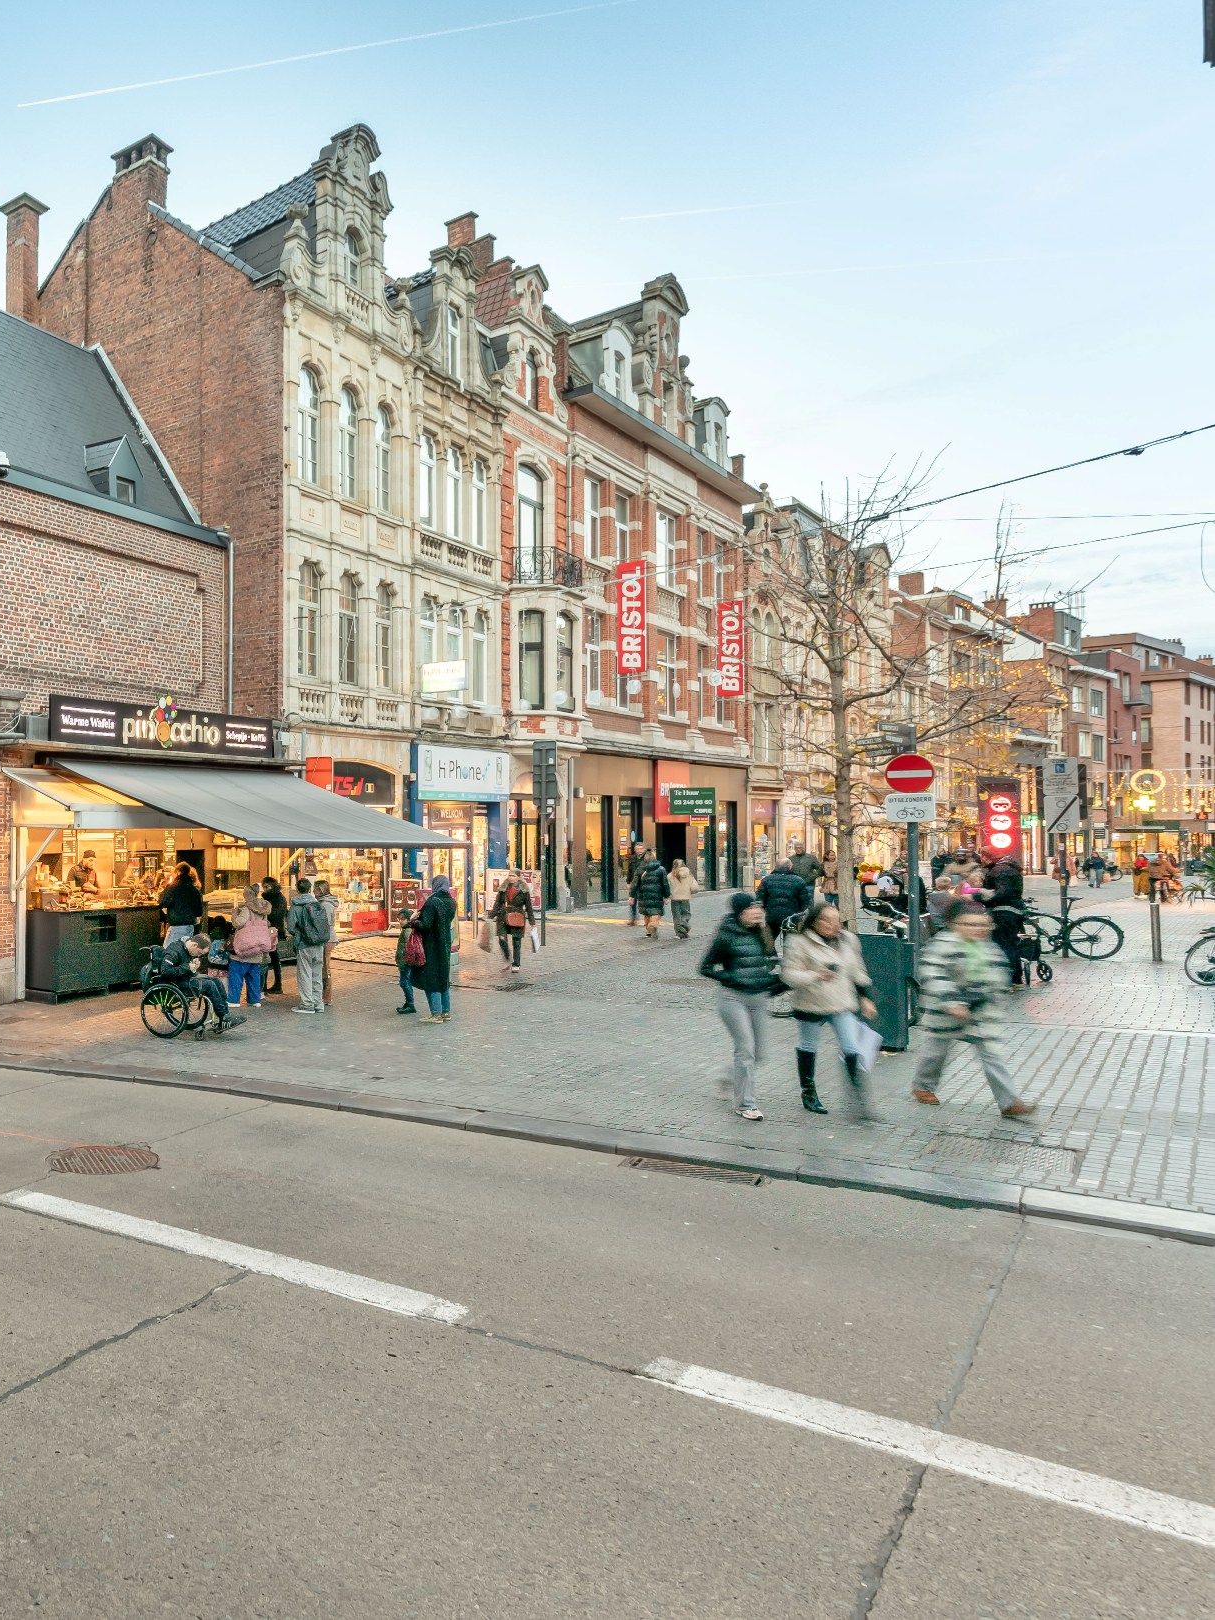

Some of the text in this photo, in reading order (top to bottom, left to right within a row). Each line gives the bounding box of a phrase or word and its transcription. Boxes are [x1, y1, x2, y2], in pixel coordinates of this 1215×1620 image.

[621, 566, 642, 668] BRISTOL
[721, 604, 740, 691] BRISTOL
[60, 713, 115, 730] Warme Wafels
[122, 710, 221, 746] pinocchio
